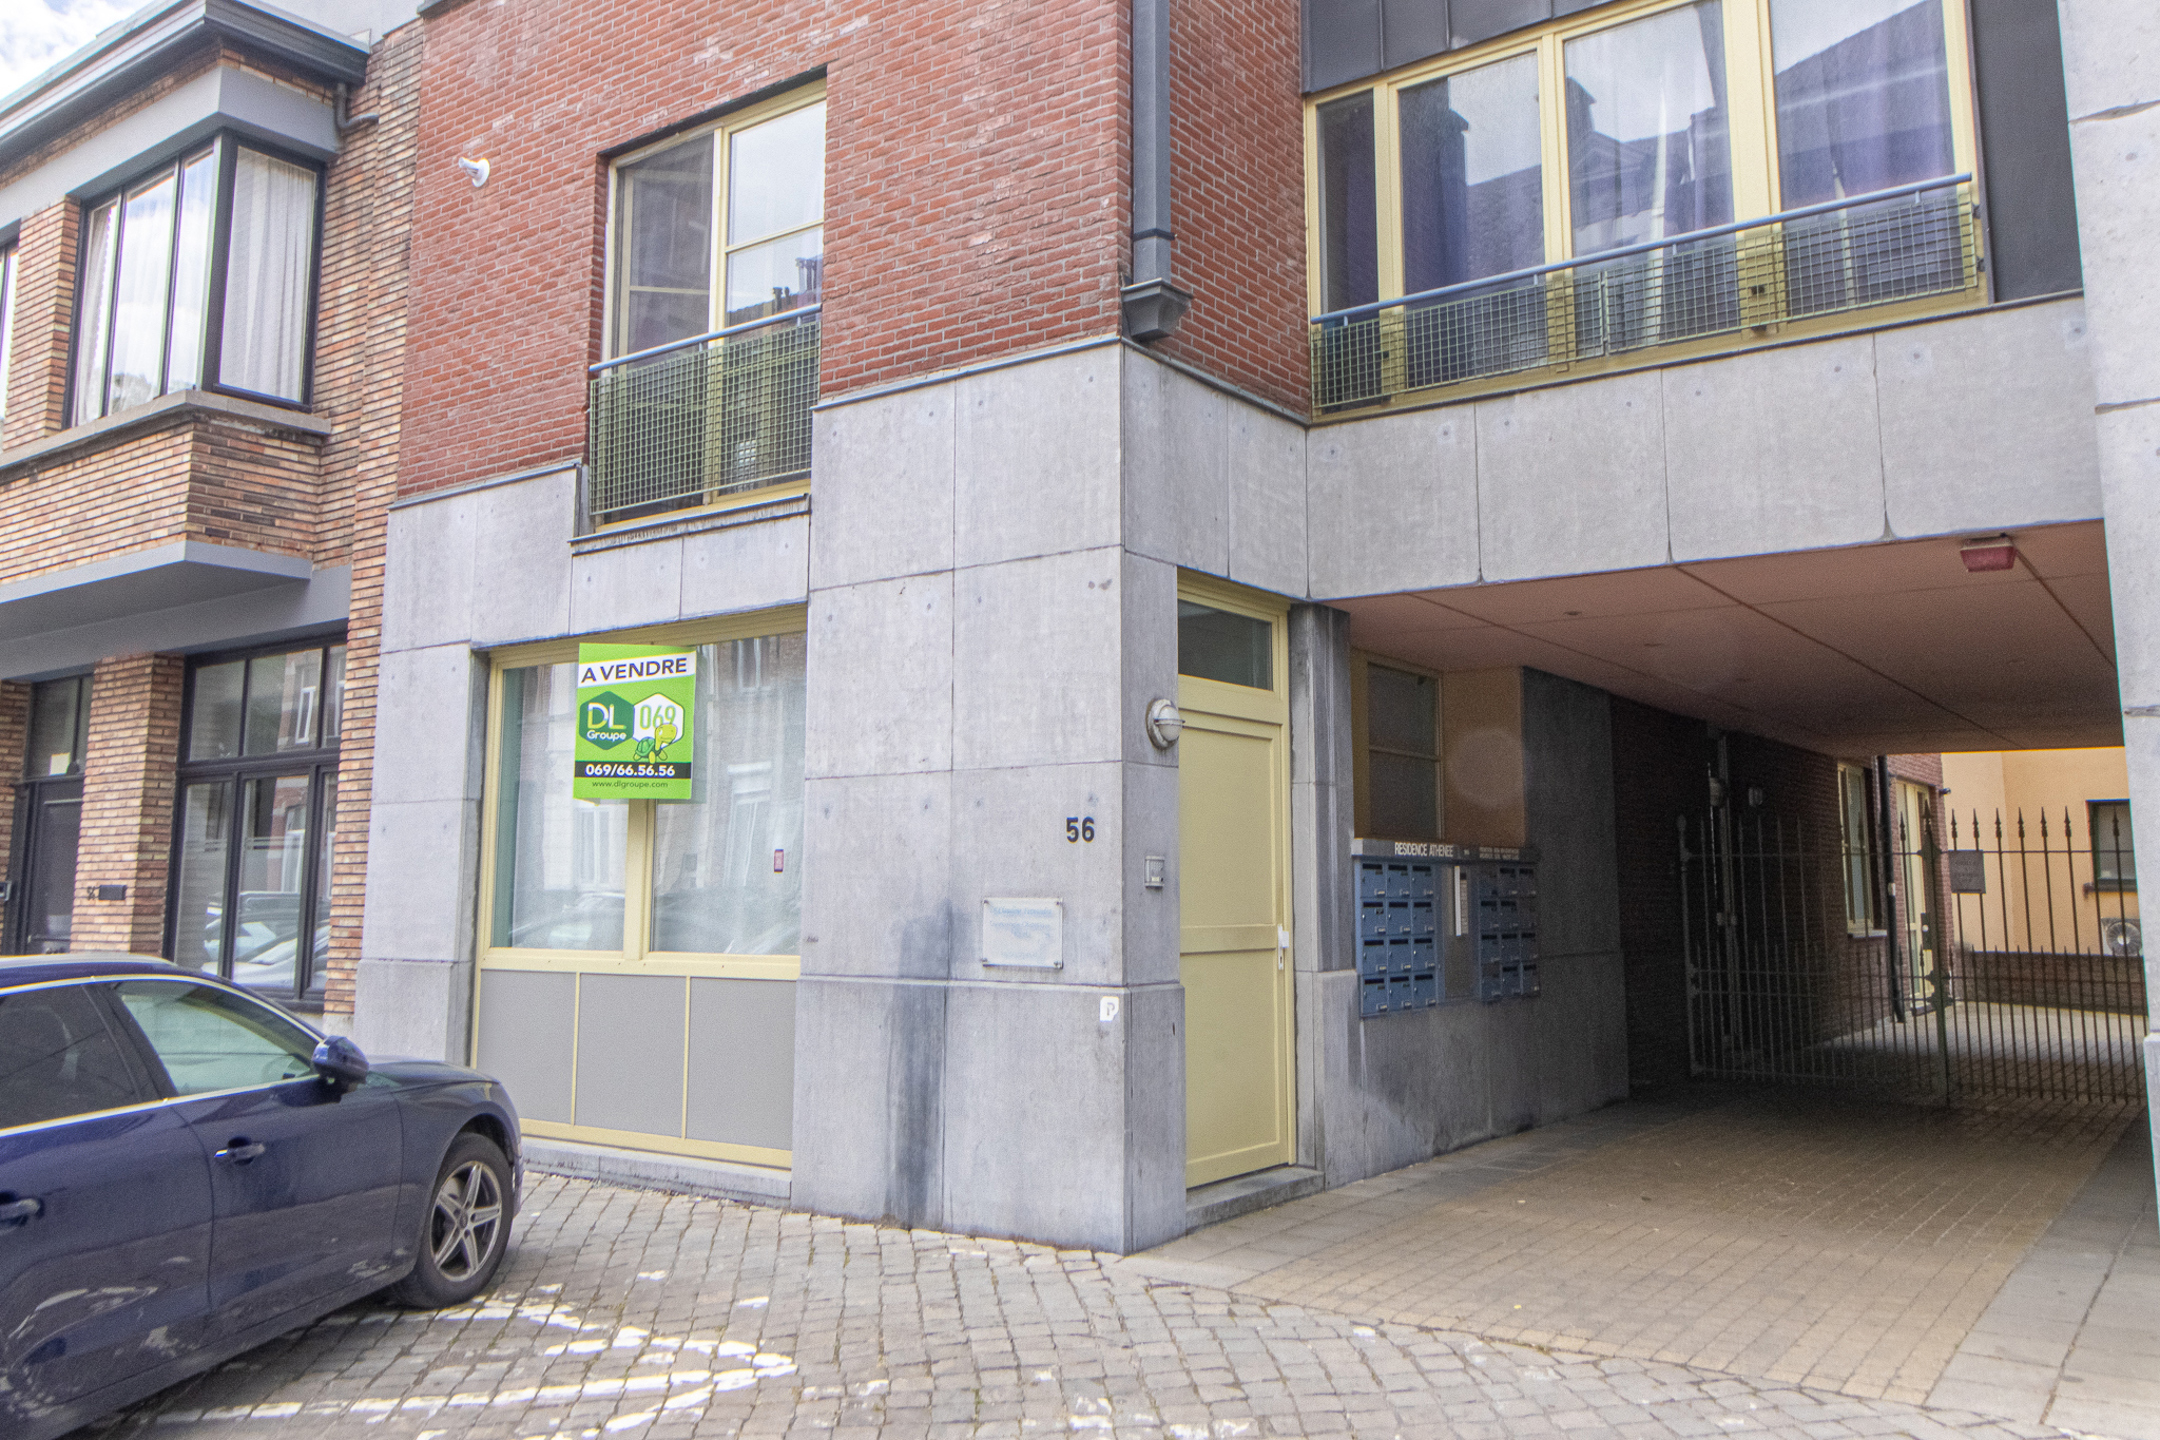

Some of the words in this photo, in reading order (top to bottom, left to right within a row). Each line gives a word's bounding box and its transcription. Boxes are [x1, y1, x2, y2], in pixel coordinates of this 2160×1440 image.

[581, 667, 597, 684] A
[600, 657, 687, 681] VENDRE
[587, 702, 627, 729] DL
[639, 704, 677, 730] 069
[586, 729, 627, 741] Groupe
[585, 763, 676, 777] 069/66.56.56
[592, 779, 669, 789] www.dlgroupe.com
[1066, 816, 1095, 843] 56
[1394, 842, 1428, 857] RESIDENCE
